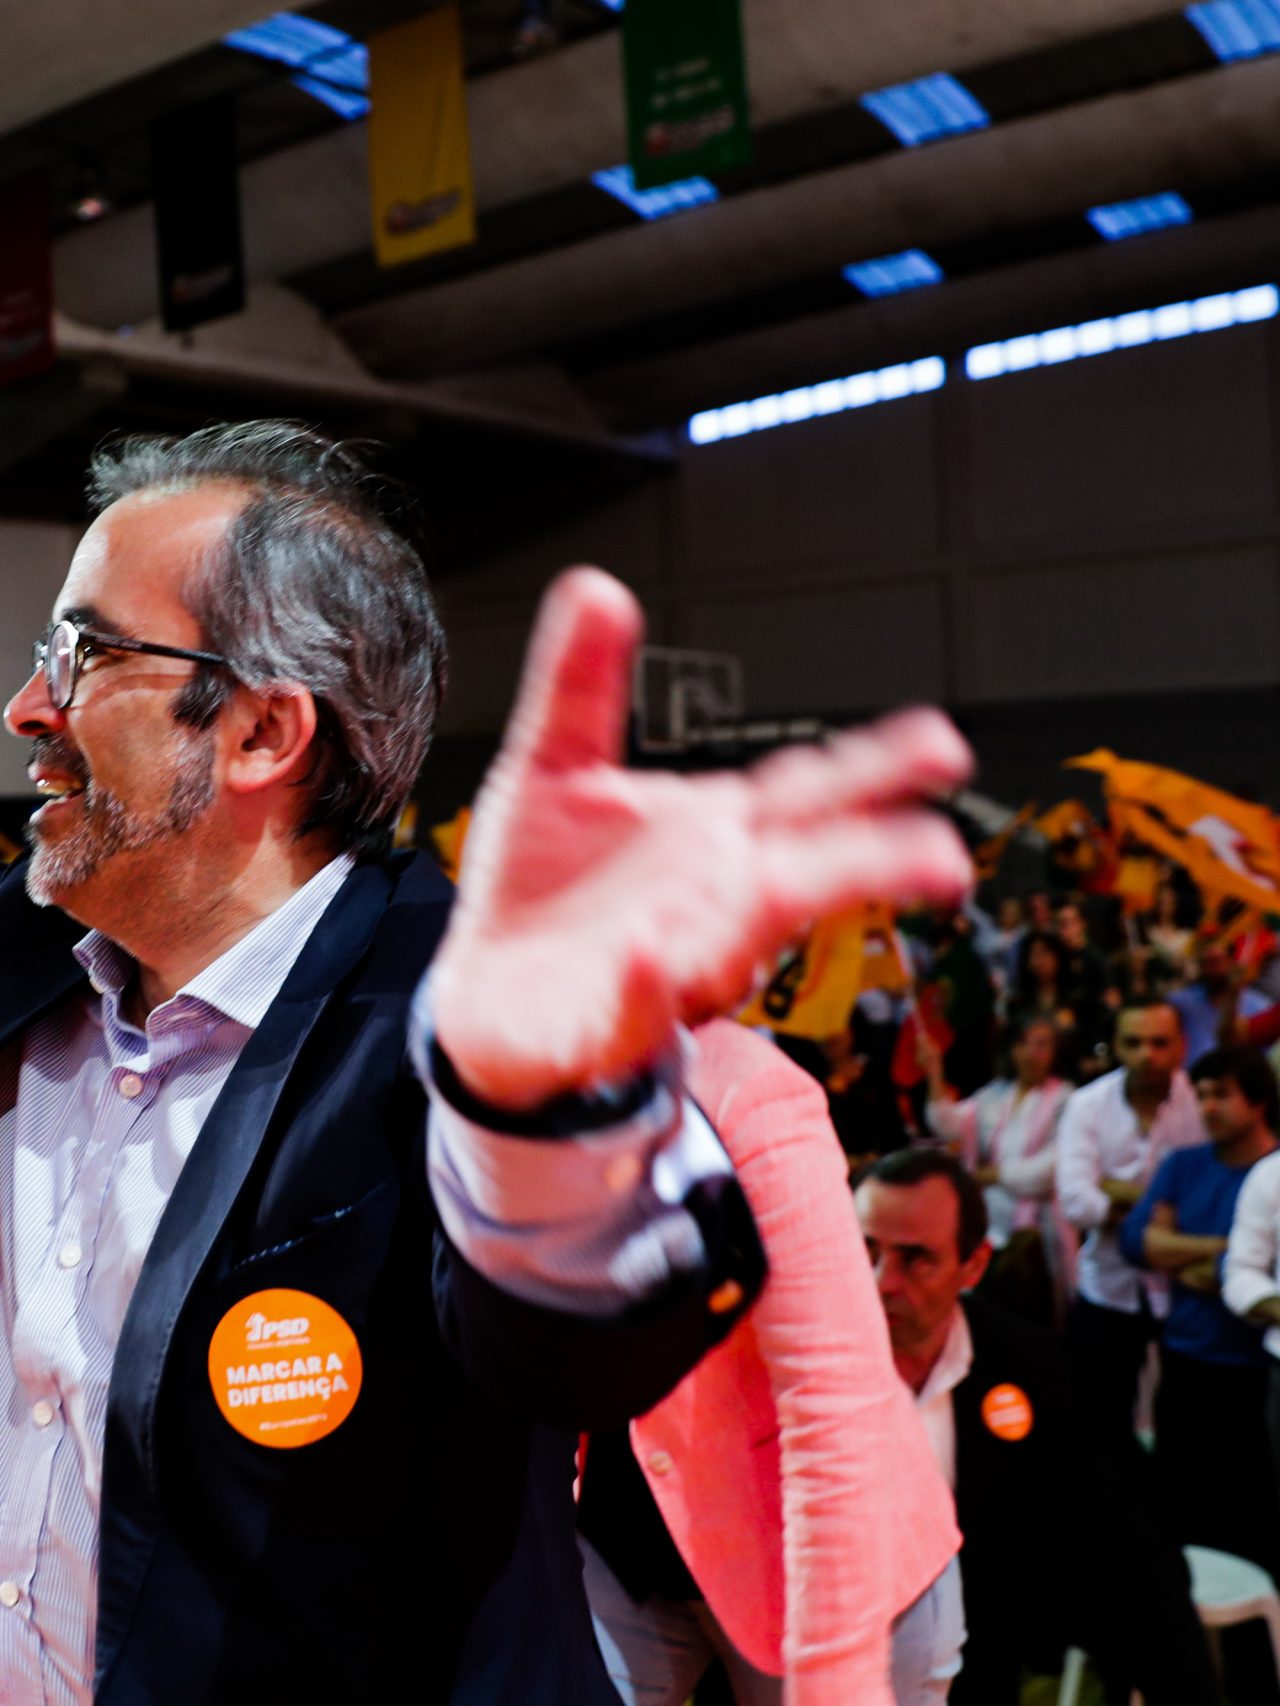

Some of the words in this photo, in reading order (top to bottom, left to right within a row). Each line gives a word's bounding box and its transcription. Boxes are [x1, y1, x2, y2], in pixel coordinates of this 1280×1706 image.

[262, 1317, 310, 1340] PSD
[226, 1355, 322, 1385] MARCAR
[326, 1352, 343, 1372] A
[227, 1374, 349, 1408] DIFERENÇA
